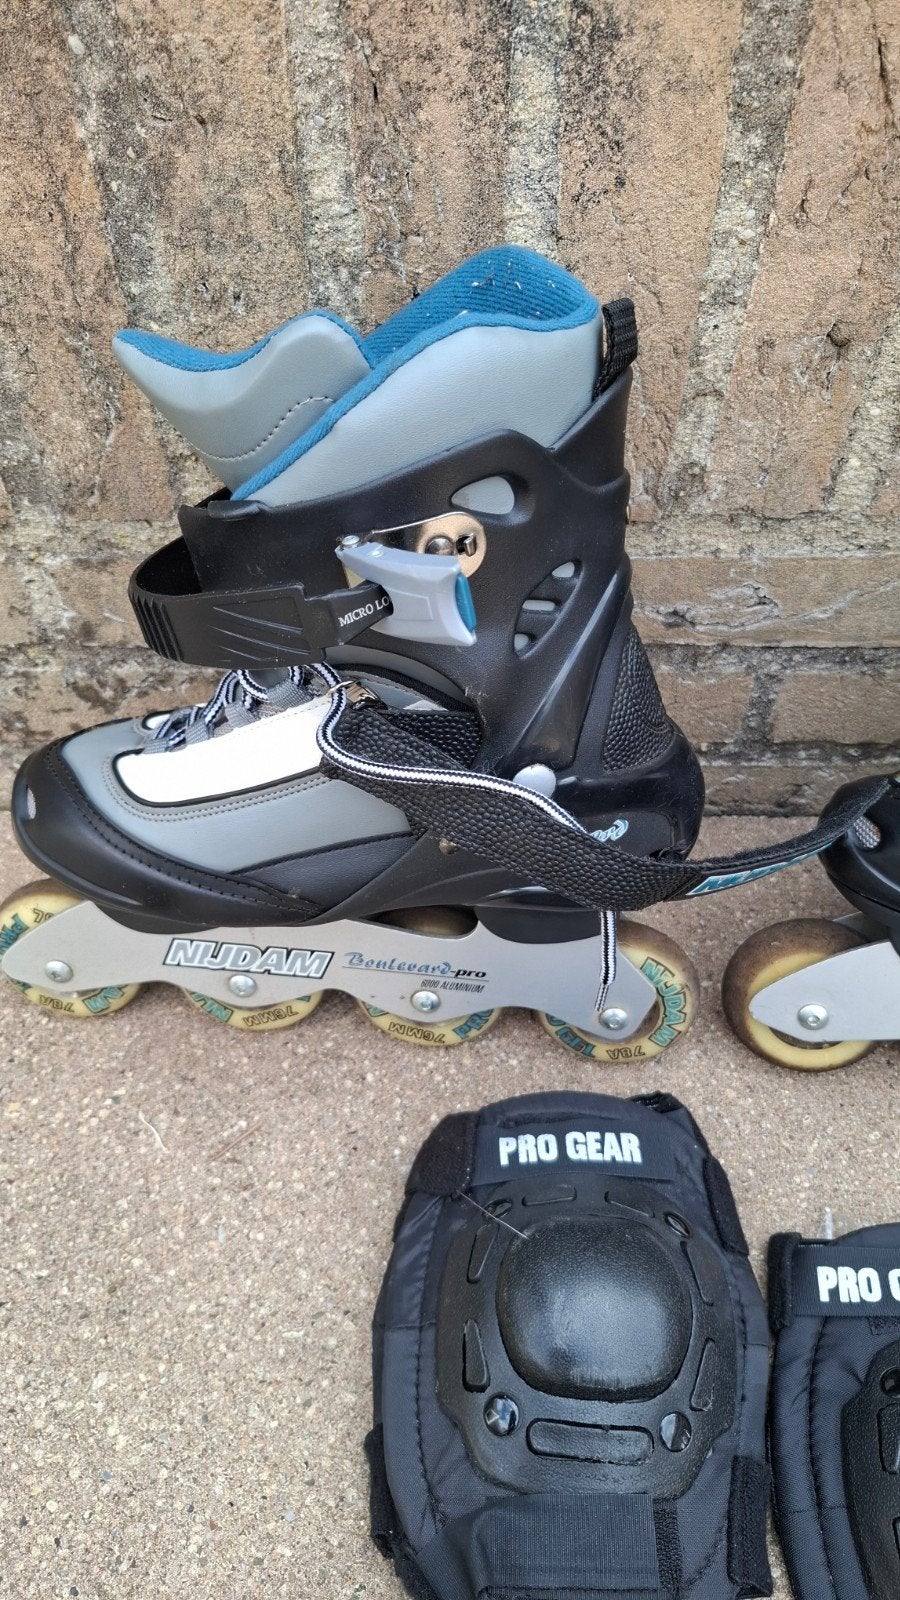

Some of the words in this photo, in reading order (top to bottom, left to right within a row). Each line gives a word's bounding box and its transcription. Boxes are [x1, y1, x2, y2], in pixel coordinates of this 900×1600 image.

[338, 603, 374, 627] MICRO
[164, 938, 335, 979] NIJDAM
[420, 978, 440, 989] 6000
[440, 979, 486, 994] ALUMINIUM
[39, 994, 76, 1013] 78A
[640, 956, 689, 1048] NIJDAM
[242, 1005, 299, 1027] 76MM
[388, 1022, 446, 1045] 76MM
[606, 1045, 645, 1060] 78A
[498, 1134, 558, 1167] PRO
[565, 1131, 643, 1164] GEAR
[816, 1265, 882, 1304] PRO
